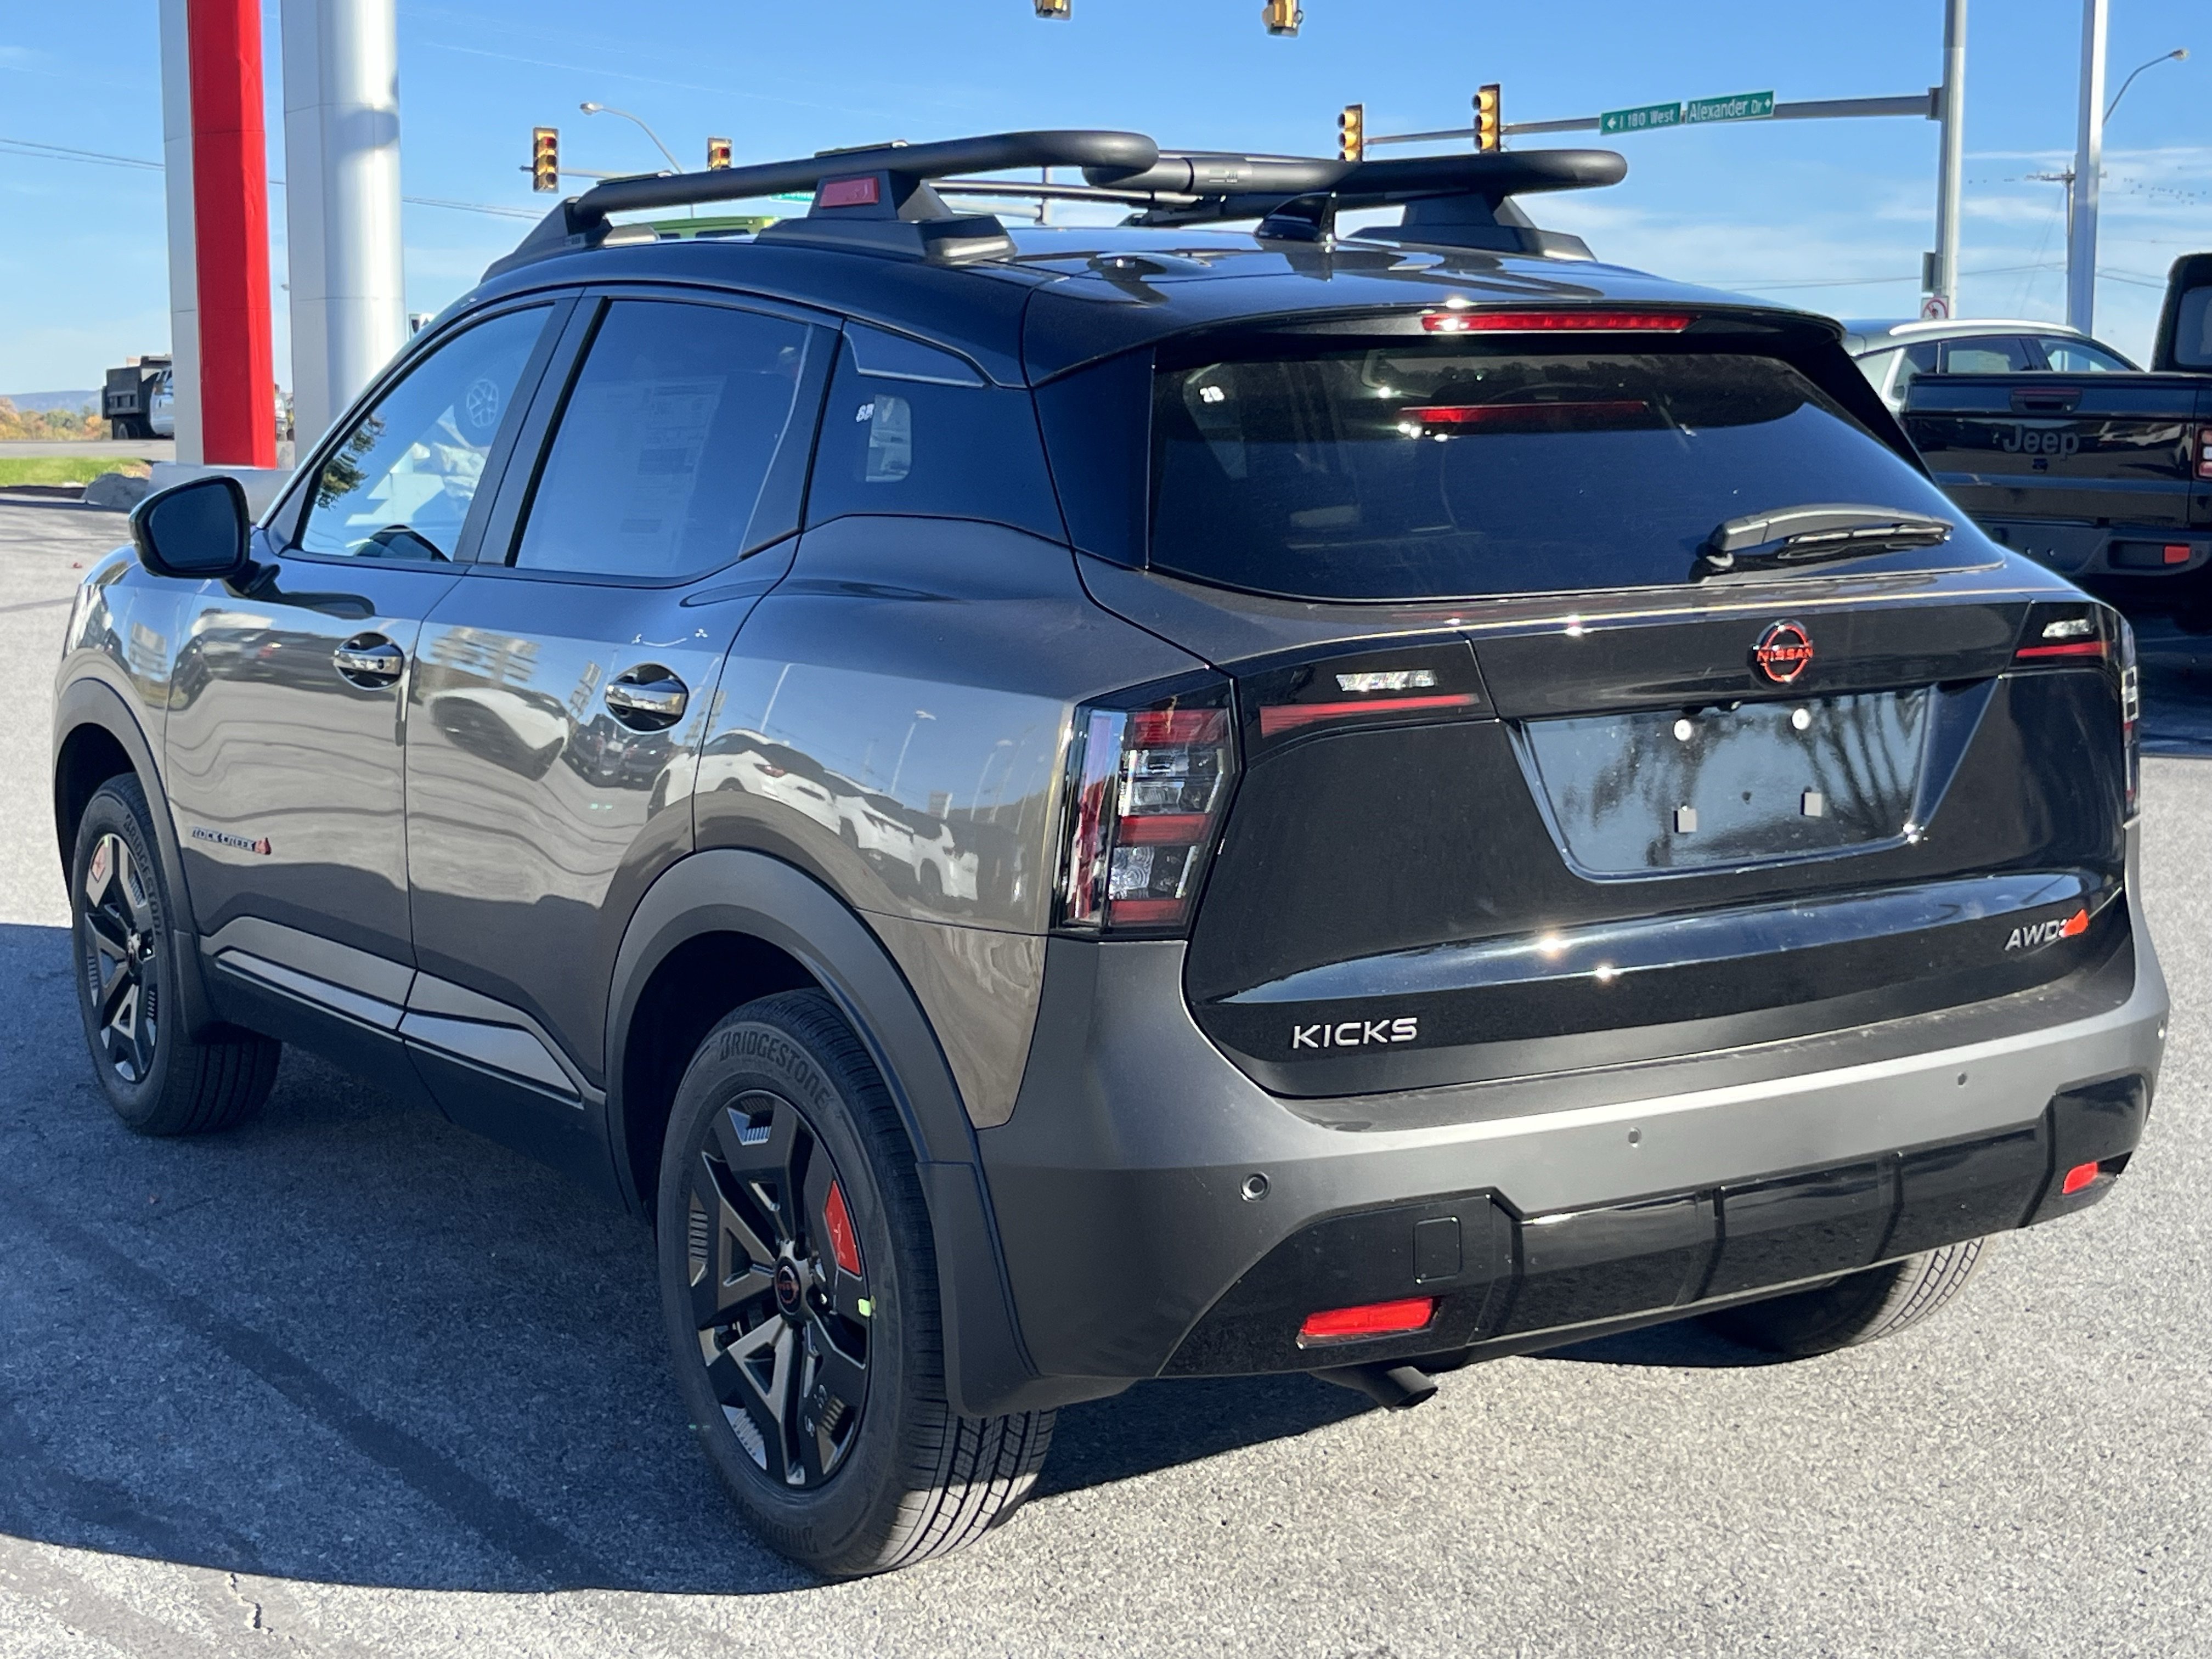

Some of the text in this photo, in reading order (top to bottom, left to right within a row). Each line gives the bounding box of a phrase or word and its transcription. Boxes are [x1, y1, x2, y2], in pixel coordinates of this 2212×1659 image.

[1628, 112, 1645, 127] 180
[1650, 109, 1674, 124] West
[1689, 99, 1763, 121] Alexander Dr
[2003, 424, 2079, 461] Jeep
[1757, 648, 1814, 662] NISSAN
[2005, 919, 2059, 951] AWD
[1293, 1017, 1418, 1049] KICKS
[719, 1030, 833, 1111] BRIDGESTONE
